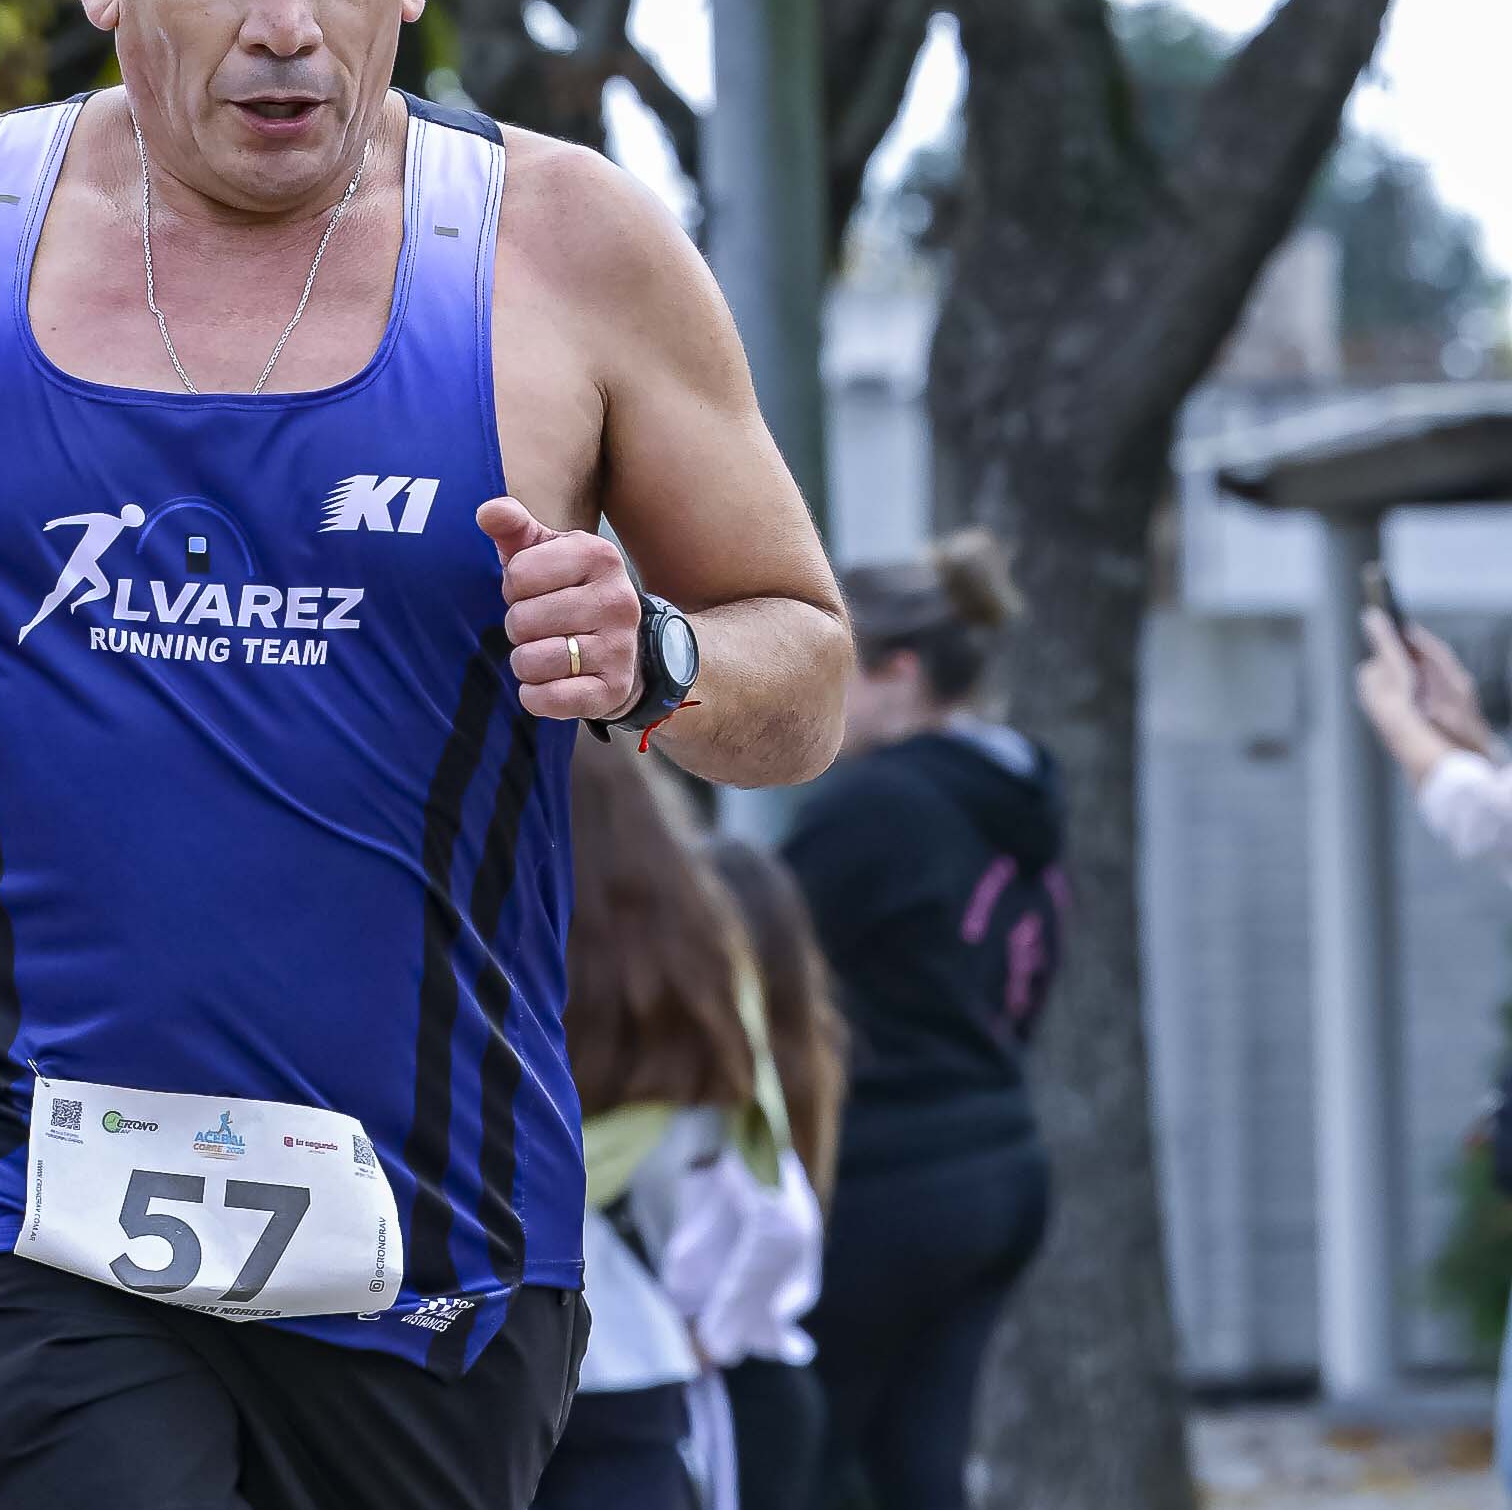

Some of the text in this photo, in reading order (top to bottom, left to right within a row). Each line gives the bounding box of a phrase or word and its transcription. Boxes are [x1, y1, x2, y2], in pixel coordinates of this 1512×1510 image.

[317, 474, 440, 534] K1
[90, 626, 328, 665] RUNNING TEAM
[109, 1168, 311, 1303] 57
